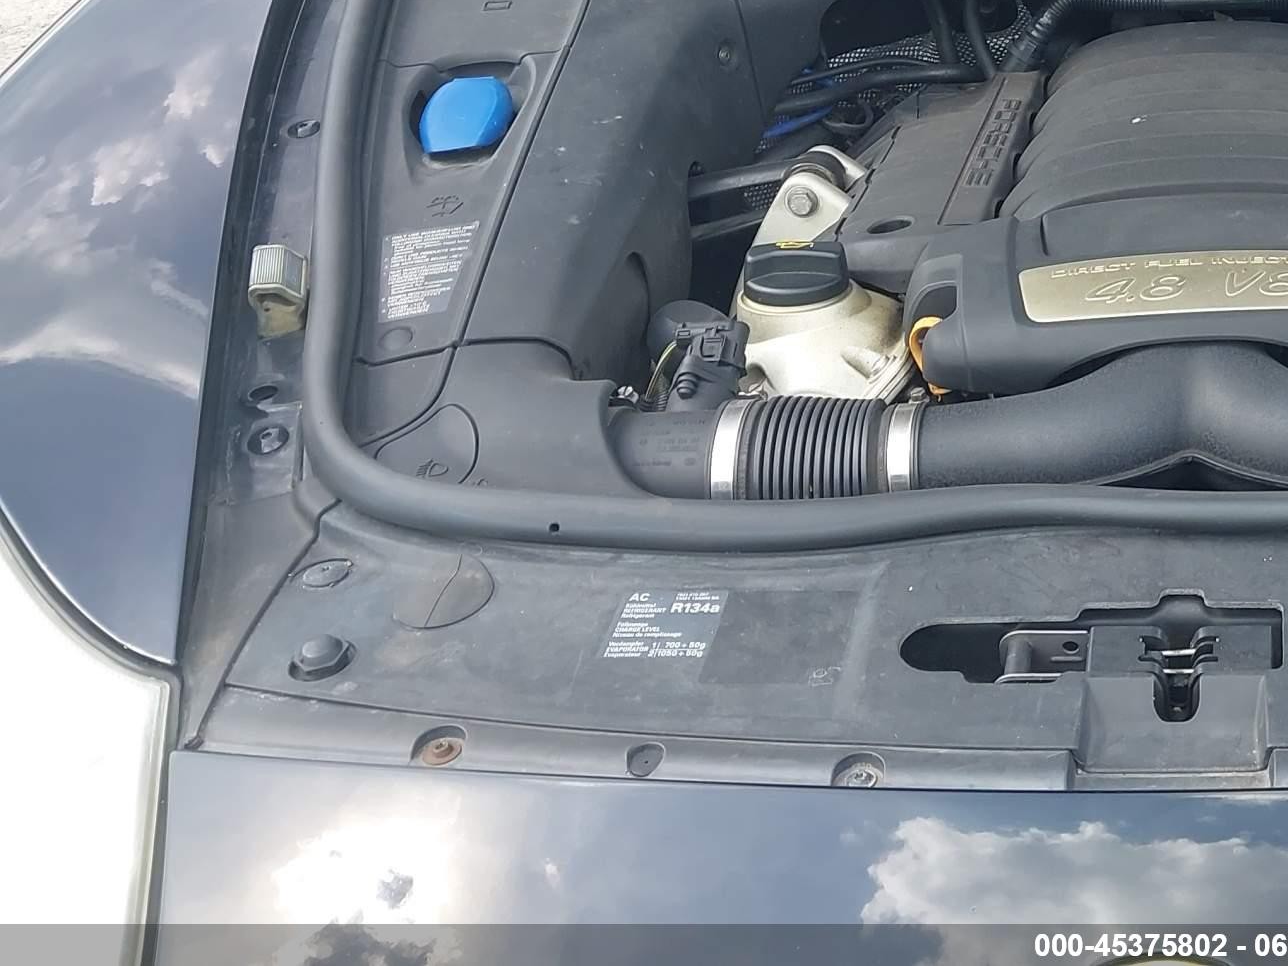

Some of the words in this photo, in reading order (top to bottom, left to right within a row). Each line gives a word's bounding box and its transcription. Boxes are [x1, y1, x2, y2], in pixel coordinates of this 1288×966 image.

[961, 98, 1023, 187] PORSCHE
[1051, 262, 1137, 278] DIRECT
[1144, 258, 1203, 269] FUEL
[1085, 273, 1187, 304] 4.8
[628, 593, 651, 602] AC
[670, 602, 721, 613] R134a
